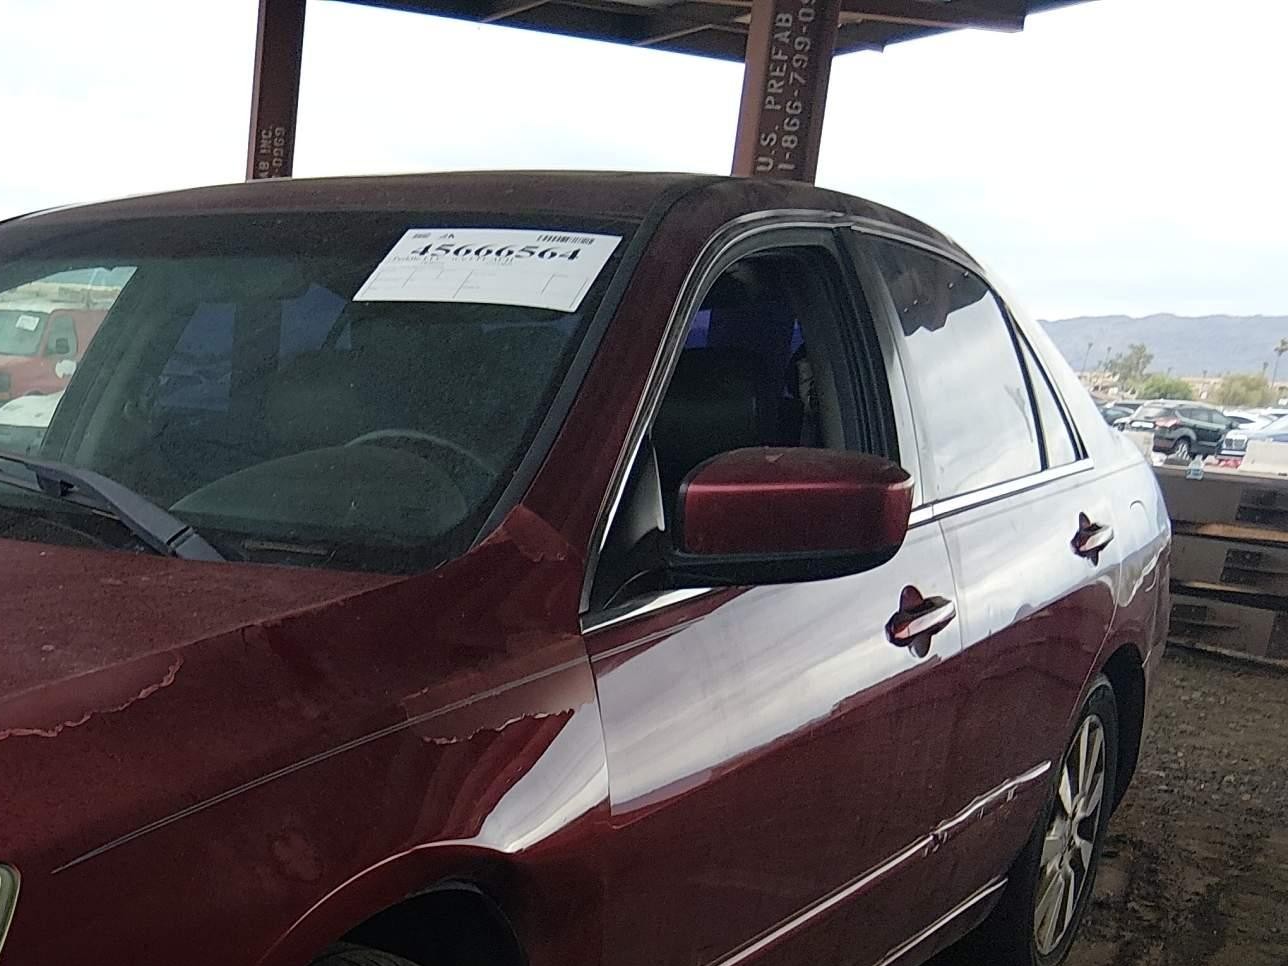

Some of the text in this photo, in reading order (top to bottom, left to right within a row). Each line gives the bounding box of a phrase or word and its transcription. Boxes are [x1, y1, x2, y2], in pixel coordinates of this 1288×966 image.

[757, 12, 793, 172] U.S. PREFAB
[411, 243, 582, 261] 45666564
